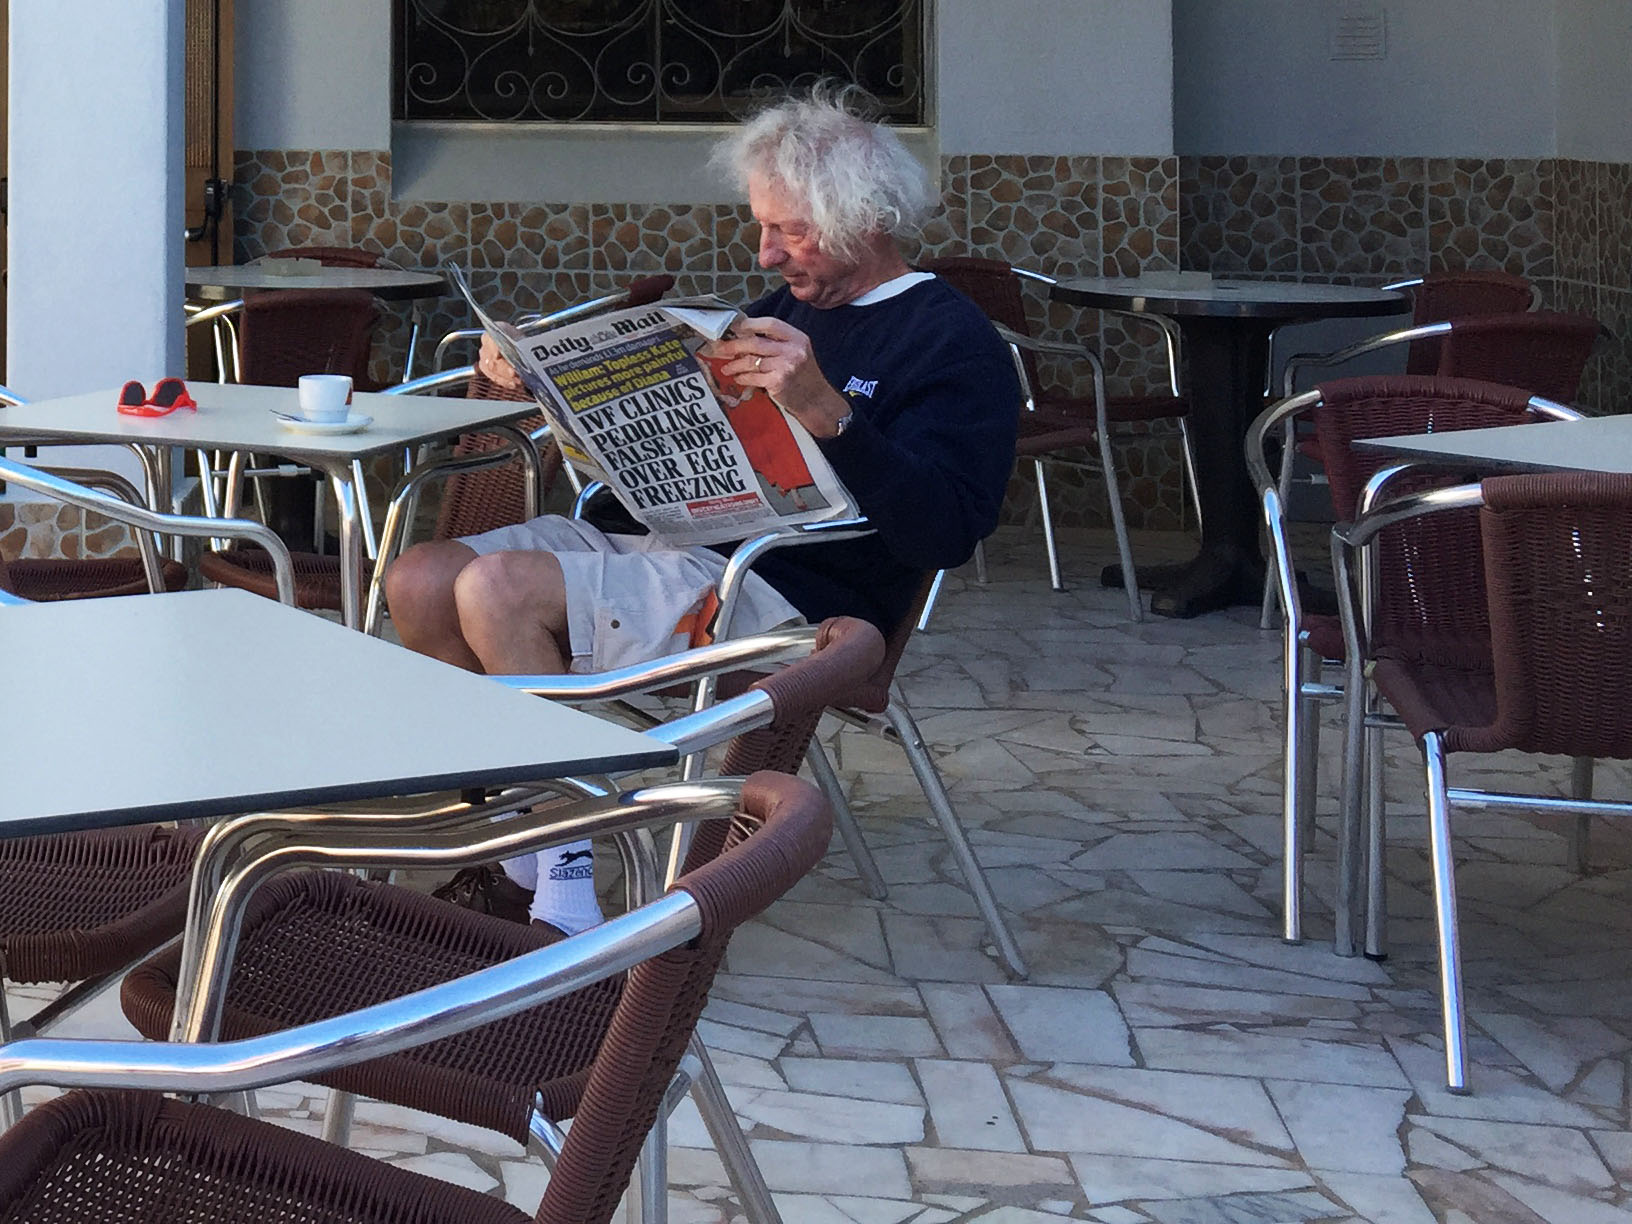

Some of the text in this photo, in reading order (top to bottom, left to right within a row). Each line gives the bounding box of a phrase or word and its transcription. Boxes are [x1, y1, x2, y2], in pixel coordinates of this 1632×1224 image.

[531, 336, 594, 362] Daily
[611, 311, 666, 335] Mail
[554, 364, 607, 386] William:
[603, 349, 652, 372] Topless
[649, 339, 682, 356] Kate
[563, 377, 612, 400] pictures
[611, 366, 644, 383] more
[642, 349, 689, 373] painful
[571, 370, 671, 412] because of Diana
[577, 376, 706, 434] IVF CLINICS
[590, 403, 711, 453] PEDDLING
[602, 420, 734, 471] FALSE HOPE
[618, 444, 738, 489] OVER EGG
[629, 469, 747, 510] FREEZING
